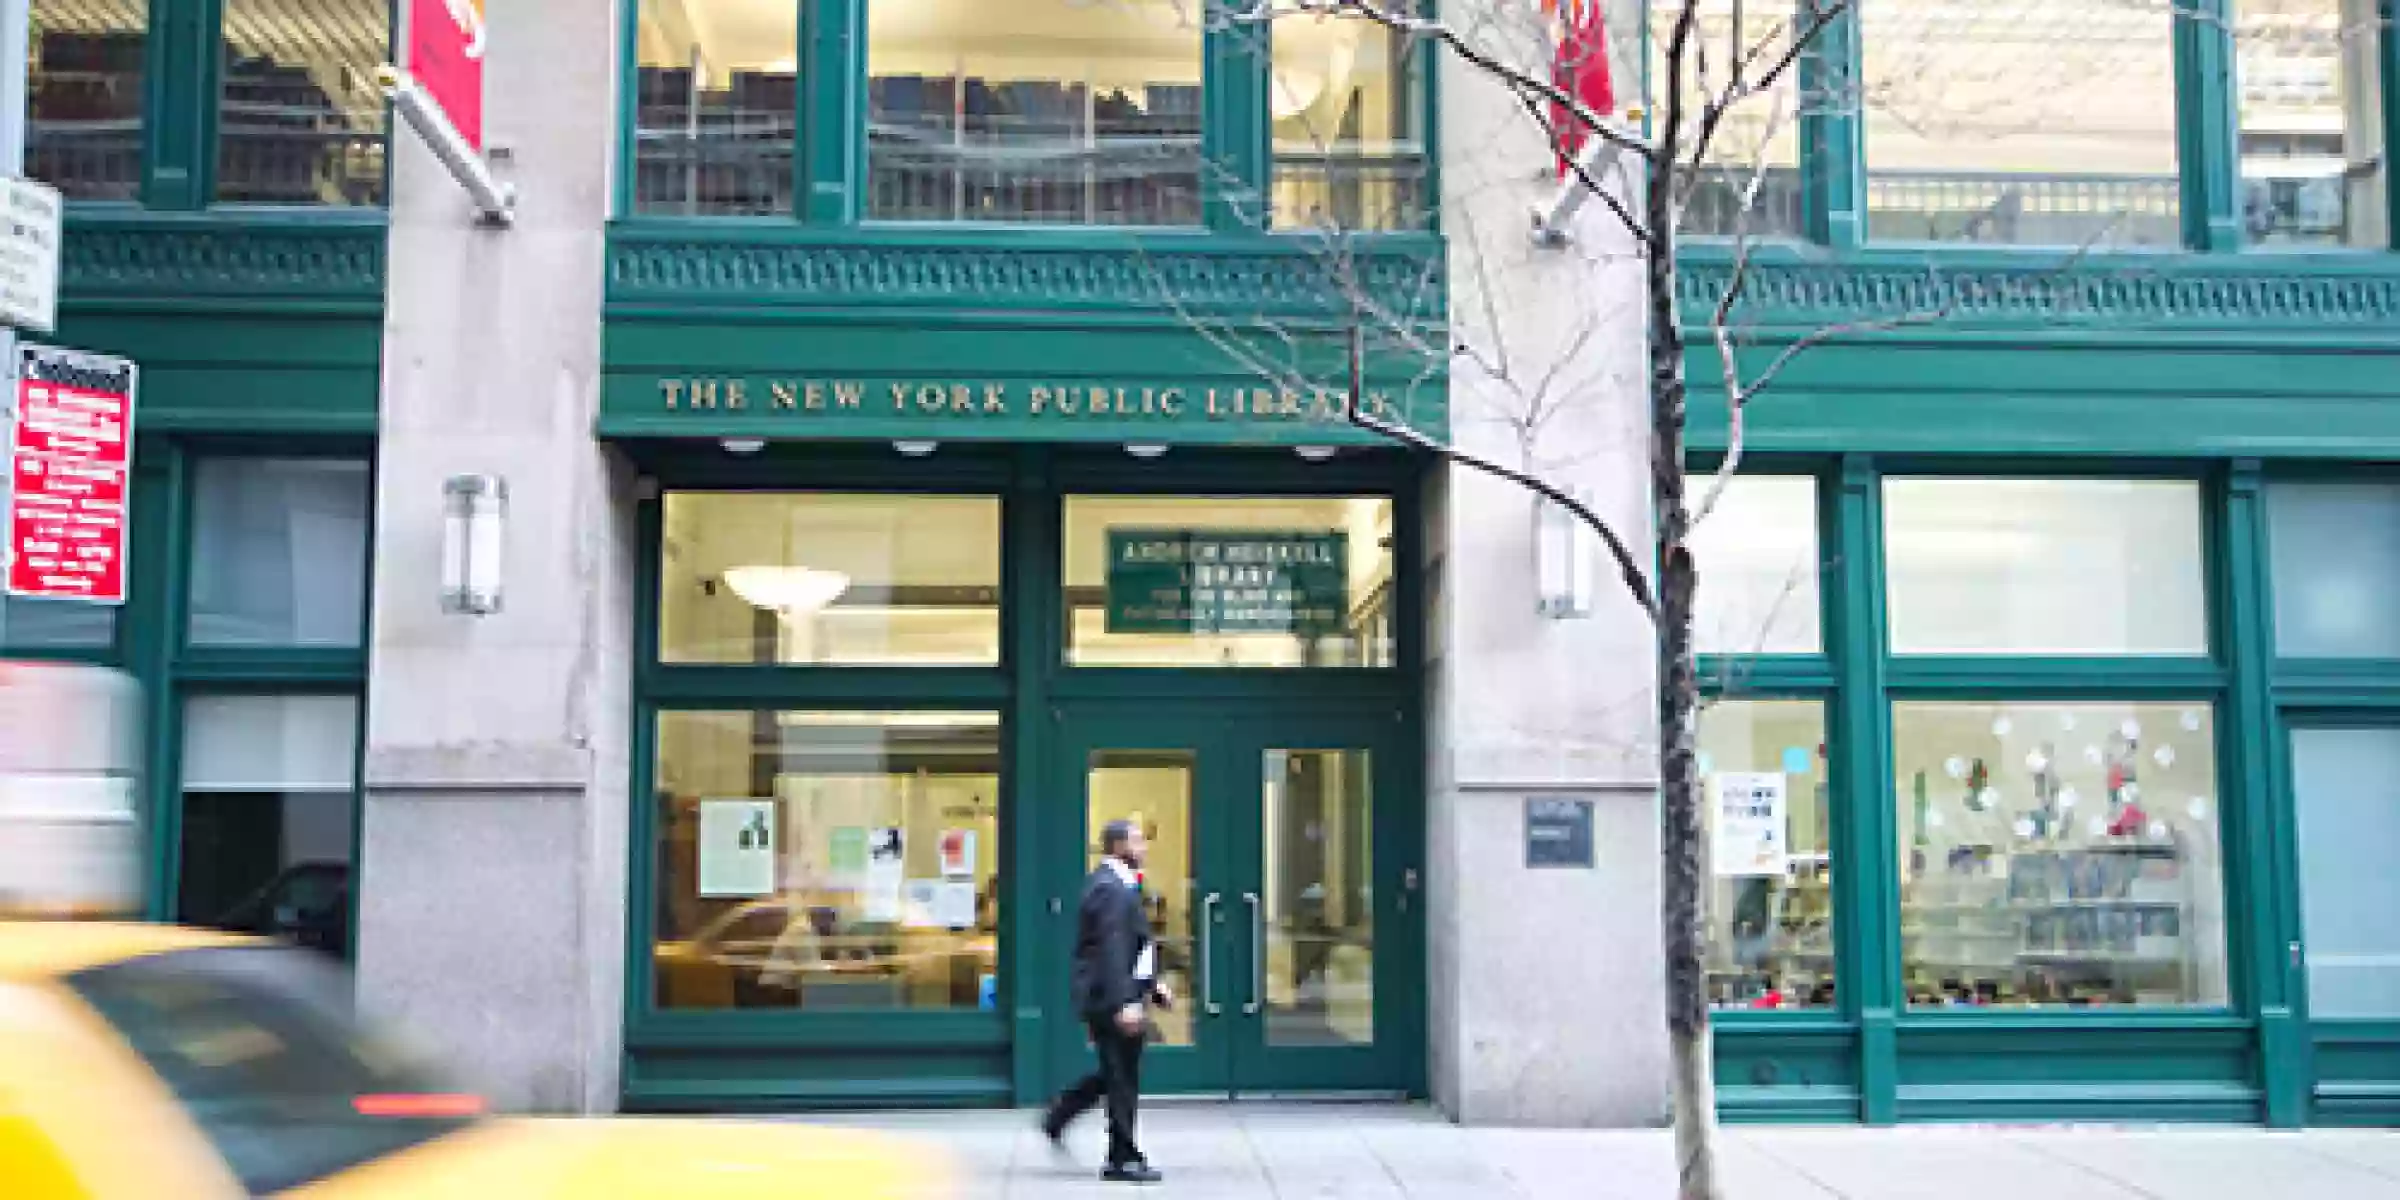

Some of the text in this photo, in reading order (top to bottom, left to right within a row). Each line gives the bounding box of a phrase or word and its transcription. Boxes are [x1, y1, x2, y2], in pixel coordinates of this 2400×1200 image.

[657, 378, 1393, 420] THE NEW YORK PUBLIC LIBRARY
